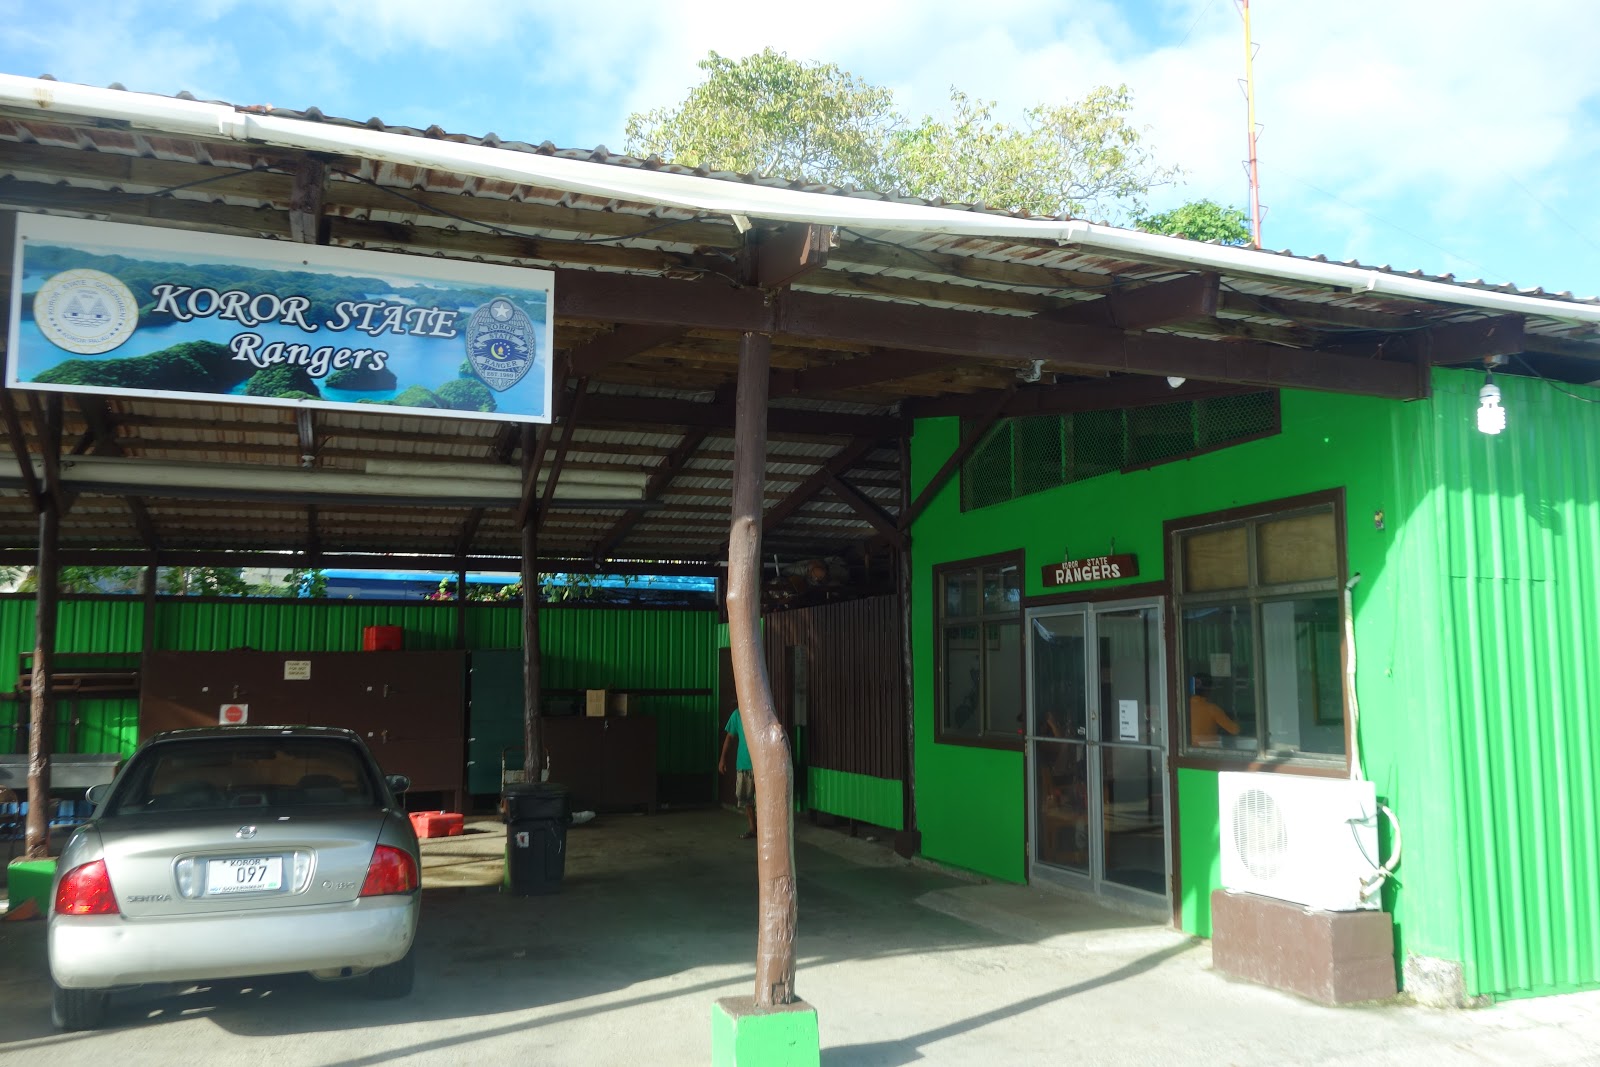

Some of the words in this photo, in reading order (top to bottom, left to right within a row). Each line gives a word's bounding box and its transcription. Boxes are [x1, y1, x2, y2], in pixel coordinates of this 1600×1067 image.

[151, 284, 318, 331] KOROR
[326, 300, 458, 337] STATE
[487, 323, 516, 334] KOROR
[489, 333, 514, 341] STATE
[230, 333, 388, 377] Rangers
[484, 358, 517, 369] RANGER
[1062, 561, 1079, 570] KOROR
[1086, 556, 1108, 567] STATE
[1055, 564, 1121, 584] RANGERS
[230, 858, 261, 867] KOROR
[236, 865, 268, 883] 097
[126, 894, 173, 903] SENTRA
